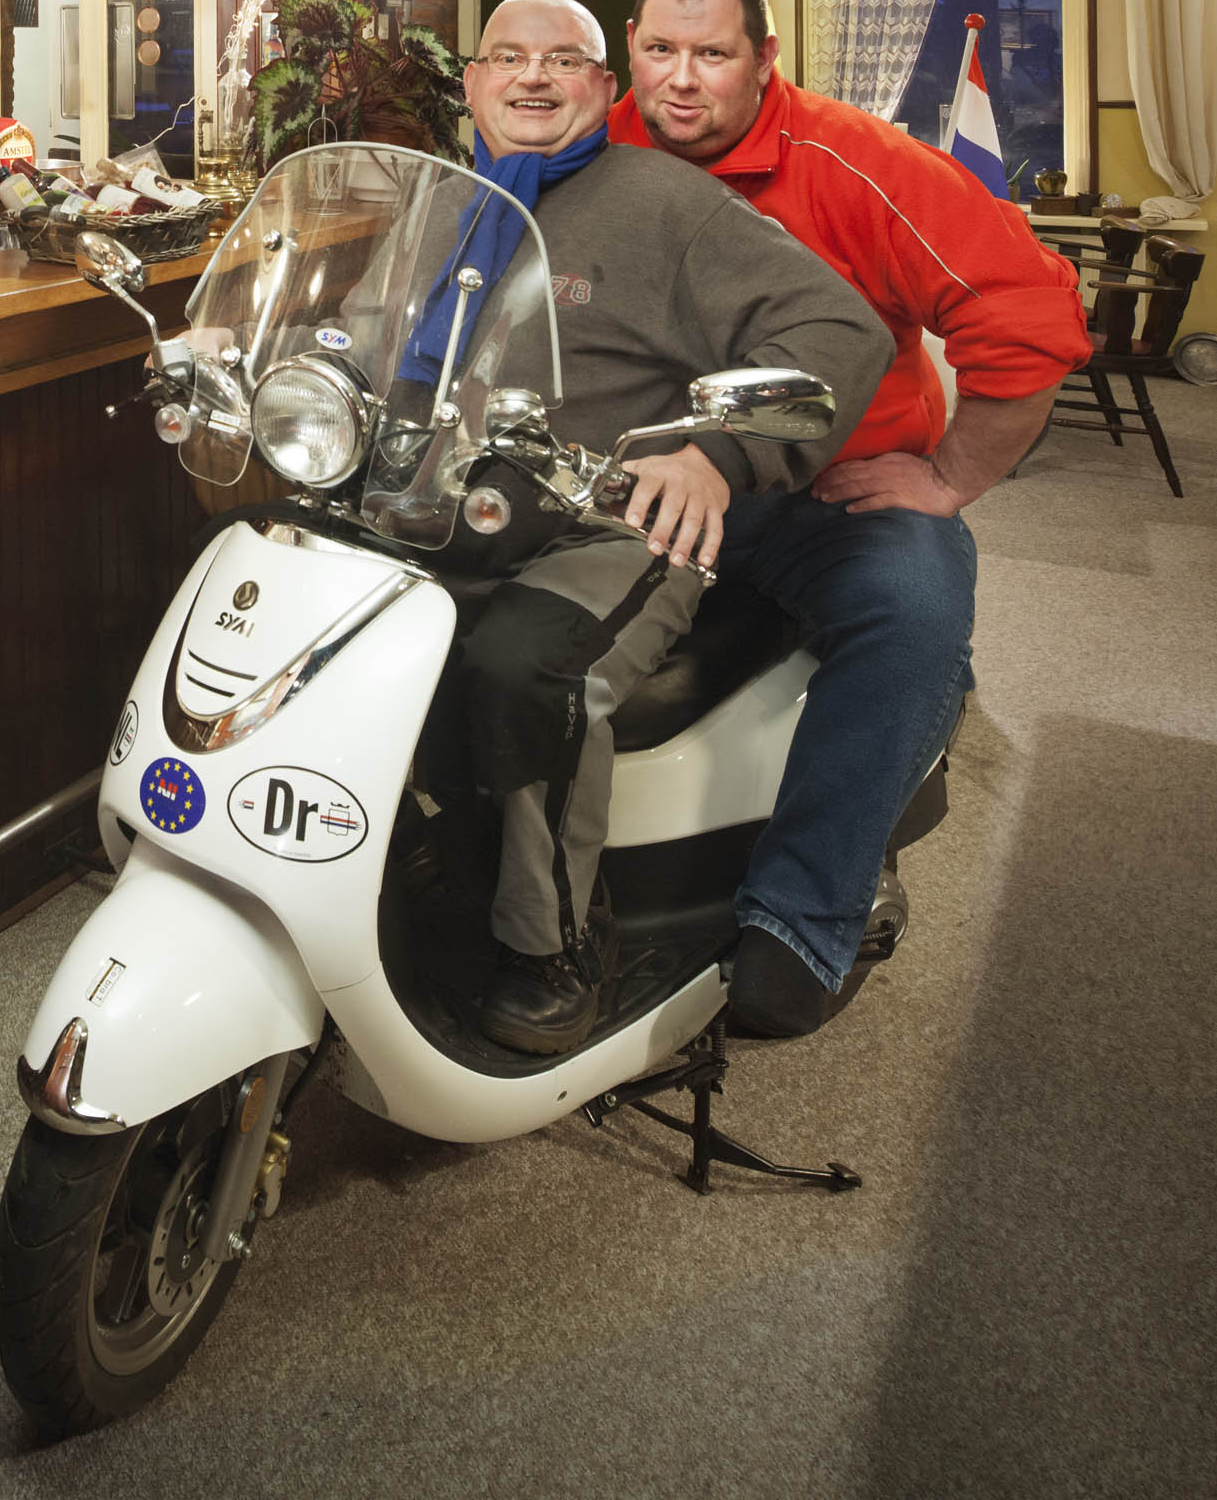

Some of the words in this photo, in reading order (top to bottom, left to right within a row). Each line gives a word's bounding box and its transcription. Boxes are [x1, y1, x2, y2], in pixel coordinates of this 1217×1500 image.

[2, 146, 32, 157] AMSTEL
[321, 332, 346, 346] SYM
[263, 777, 319, 842] Dr
